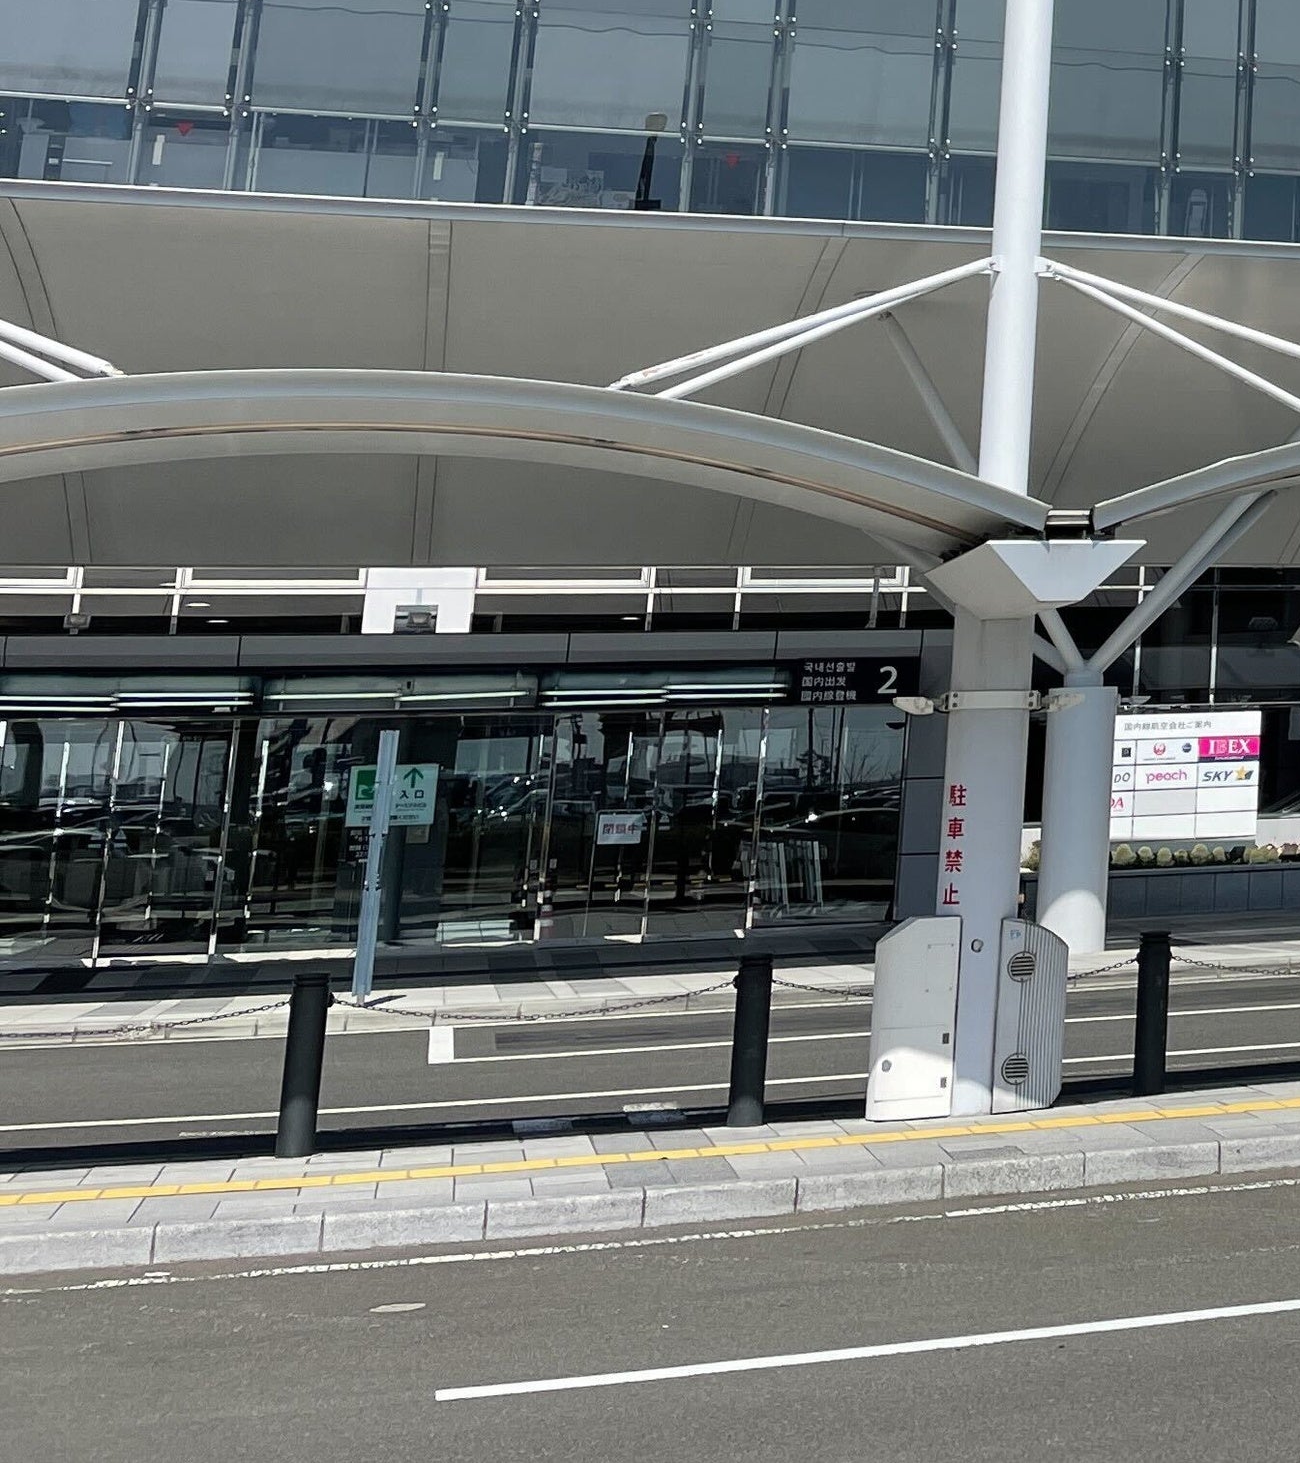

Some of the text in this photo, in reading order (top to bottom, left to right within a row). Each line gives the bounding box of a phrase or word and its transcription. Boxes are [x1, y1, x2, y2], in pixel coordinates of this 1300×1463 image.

[877, 665, 898, 694] 2
[1208, 738, 1251, 755] IBEX
[1145, 768, 1188, 785] peach
[1202, 769, 1234, 782] SKY
[399, 789, 425, 799] 入口
[942, 784, 967, 905] 駐車禁止
